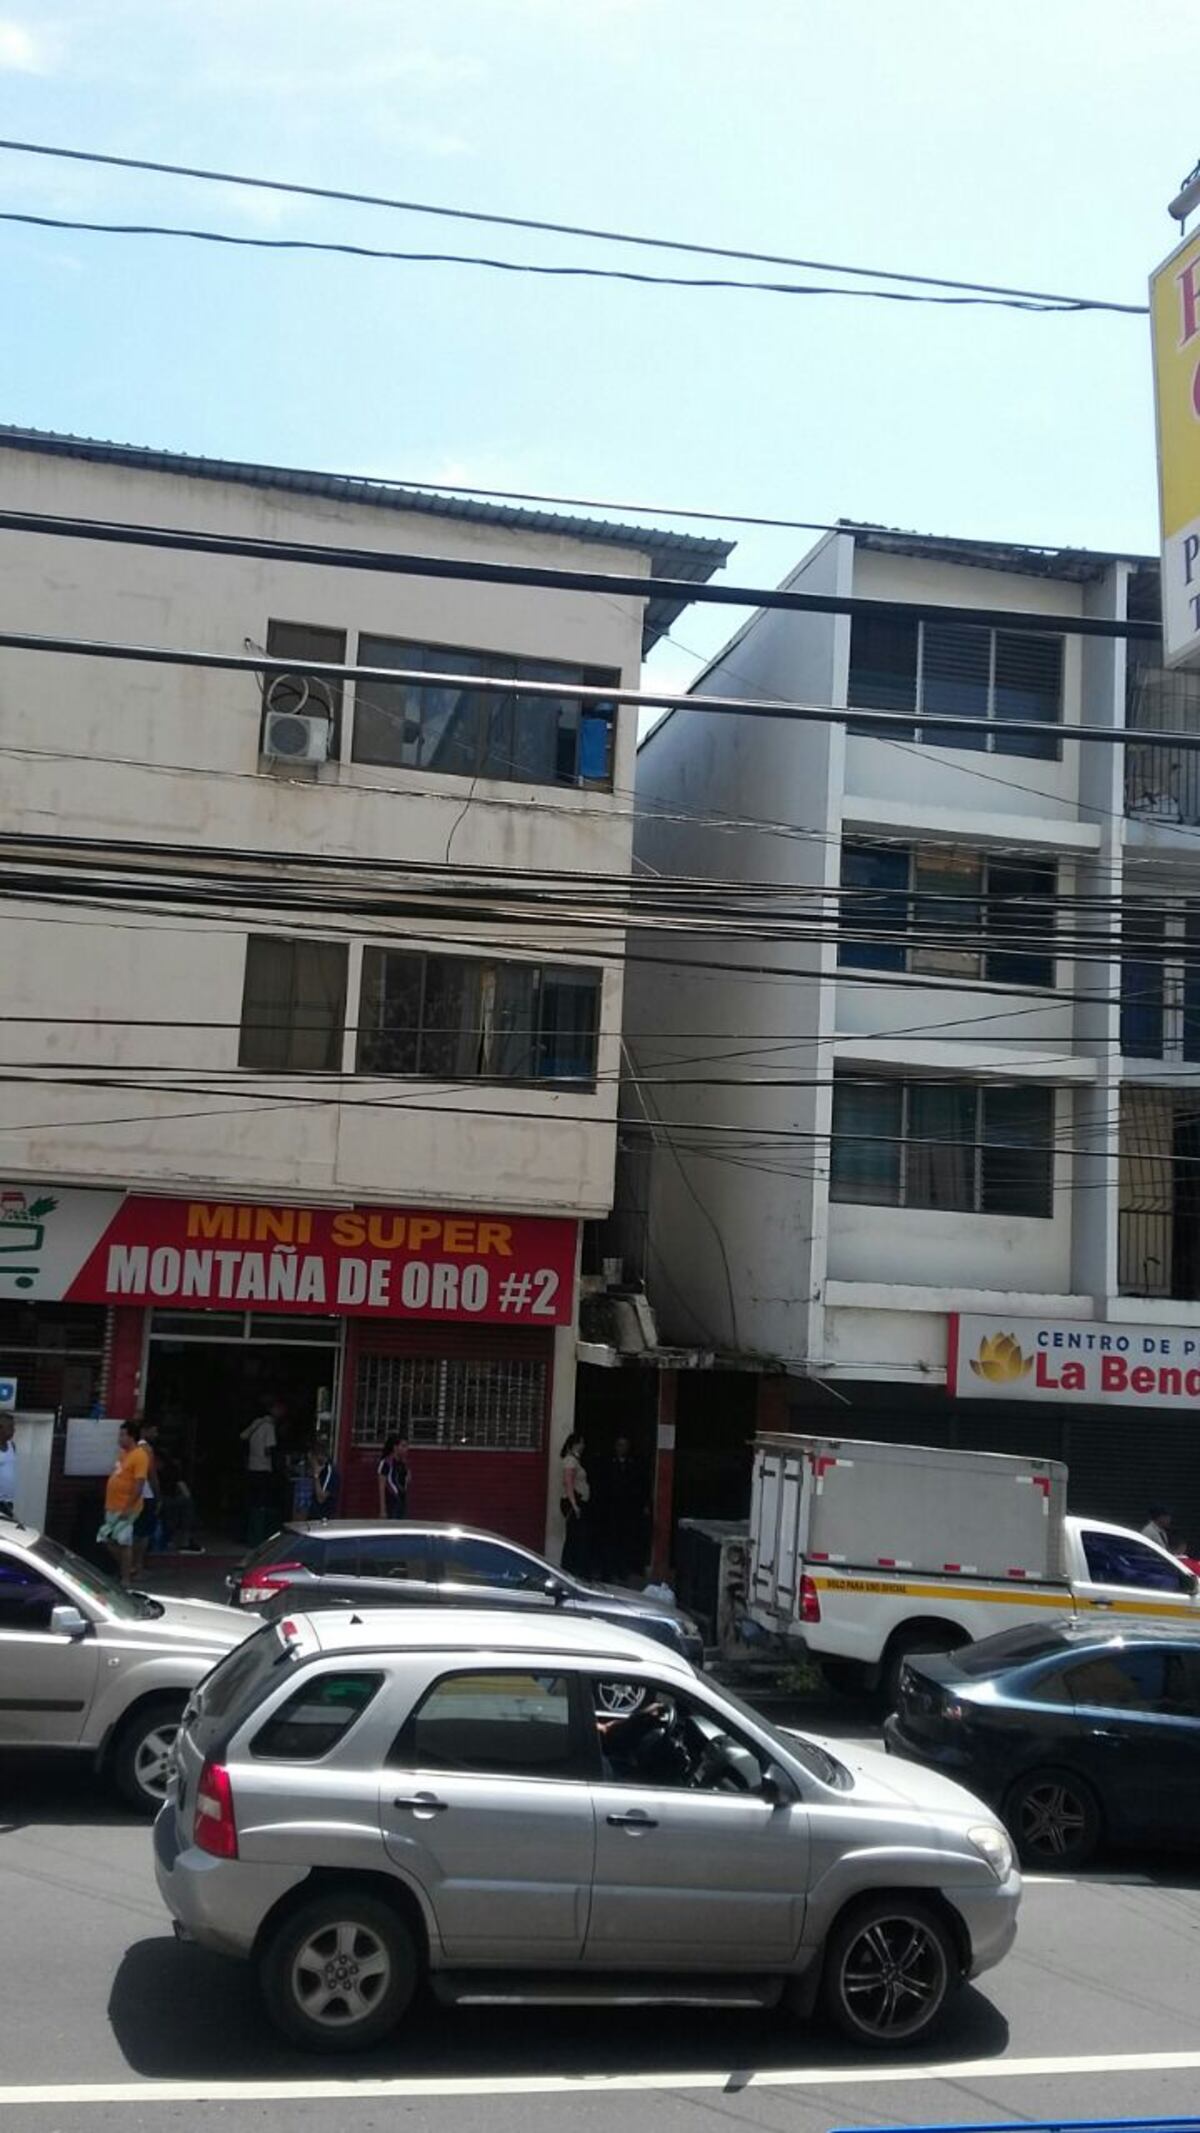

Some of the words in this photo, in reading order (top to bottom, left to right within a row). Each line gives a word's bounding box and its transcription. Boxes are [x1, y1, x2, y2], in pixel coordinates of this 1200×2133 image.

[187, 1204, 313, 1244] MINI
[331, 1213, 513, 1256] SUPER
[106, 1244, 326, 1303] MONTAÑA
[337, 1257, 391, 1306] DE
[401, 1261, 489, 1312] ORO
[499, 1268, 559, 1315] #2
[1037, 1331, 1130, 1351] CENTRO
[1143, 1338, 1170, 1354] DE
[1184, 1341, 1200, 1355] P
[1036, 1352, 1086, 1390] La
